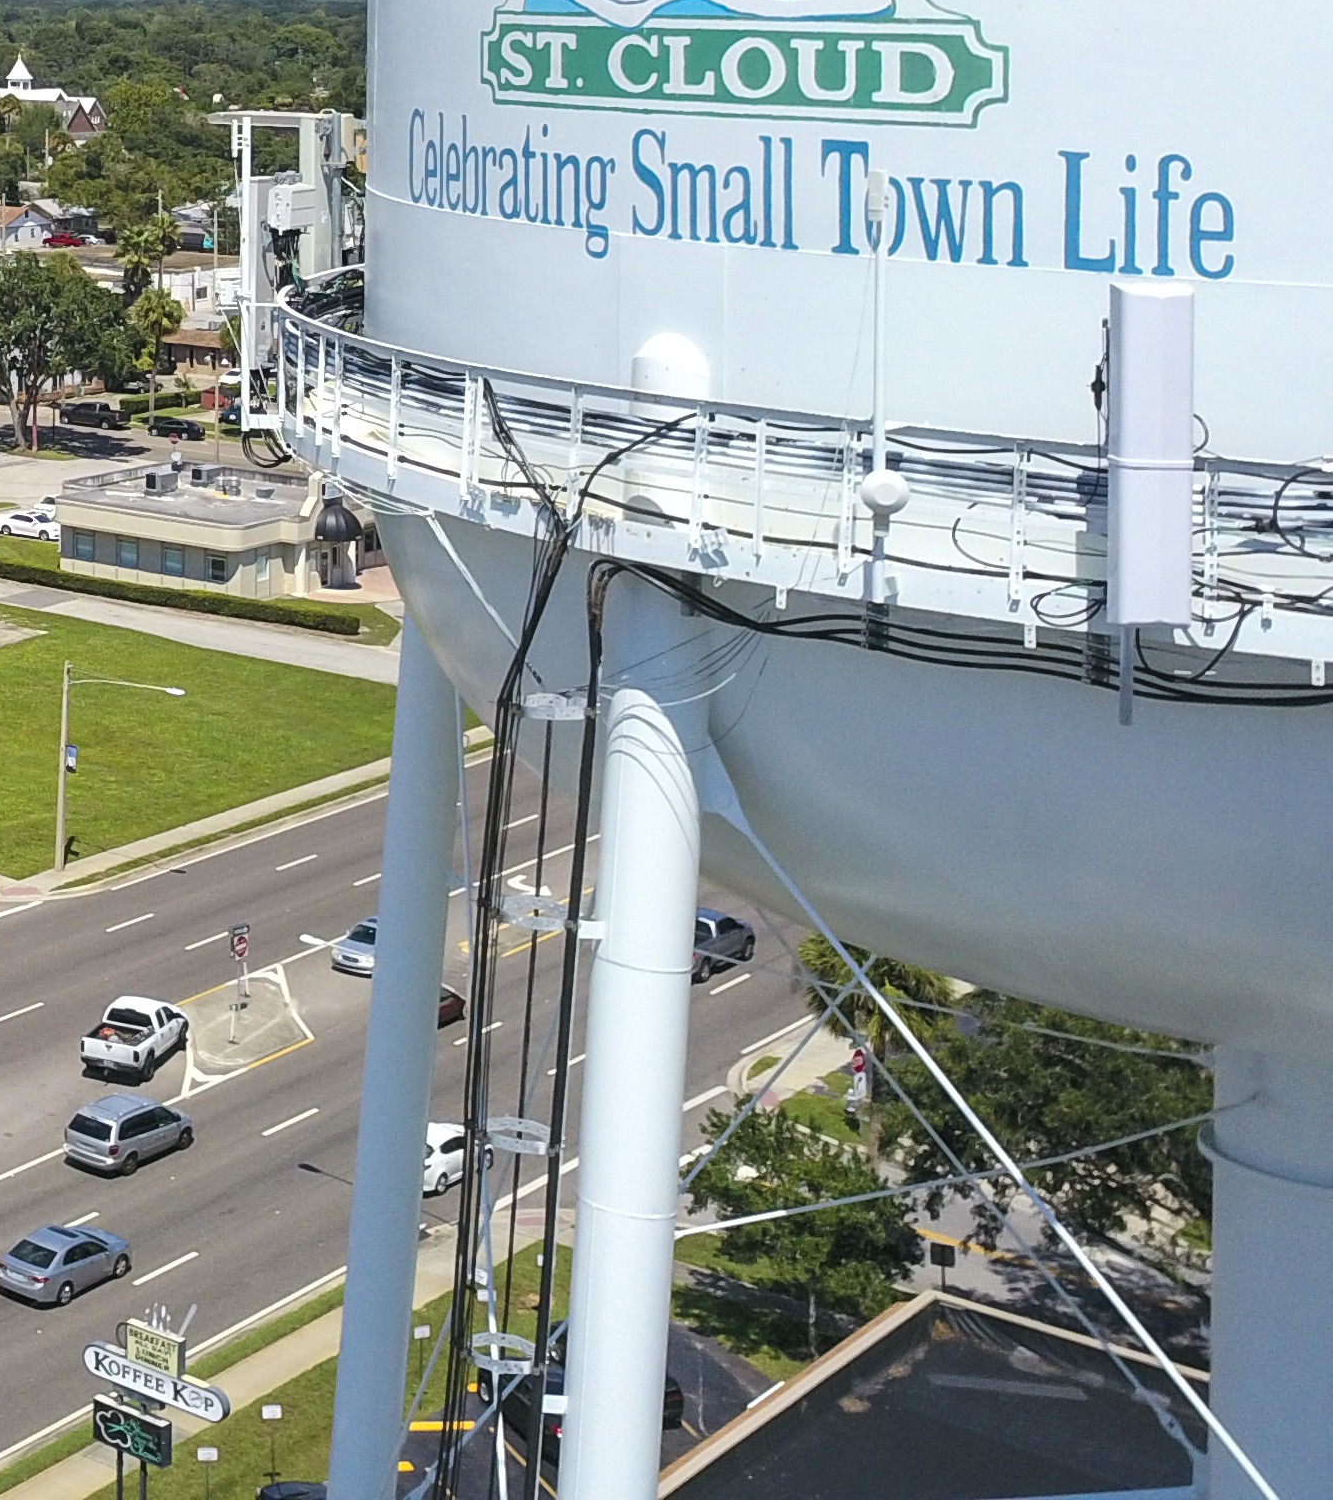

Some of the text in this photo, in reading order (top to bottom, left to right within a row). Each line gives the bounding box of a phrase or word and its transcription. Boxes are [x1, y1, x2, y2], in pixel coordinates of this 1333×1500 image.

[499, 31, 955, 104] ST. CLOUD
[408, 108, 1234, 279] Celebrating Small Town Life
[129, 1328, 178, 1353] BREAKFAST
[93, 1350, 165, 1395] KOFFEE
